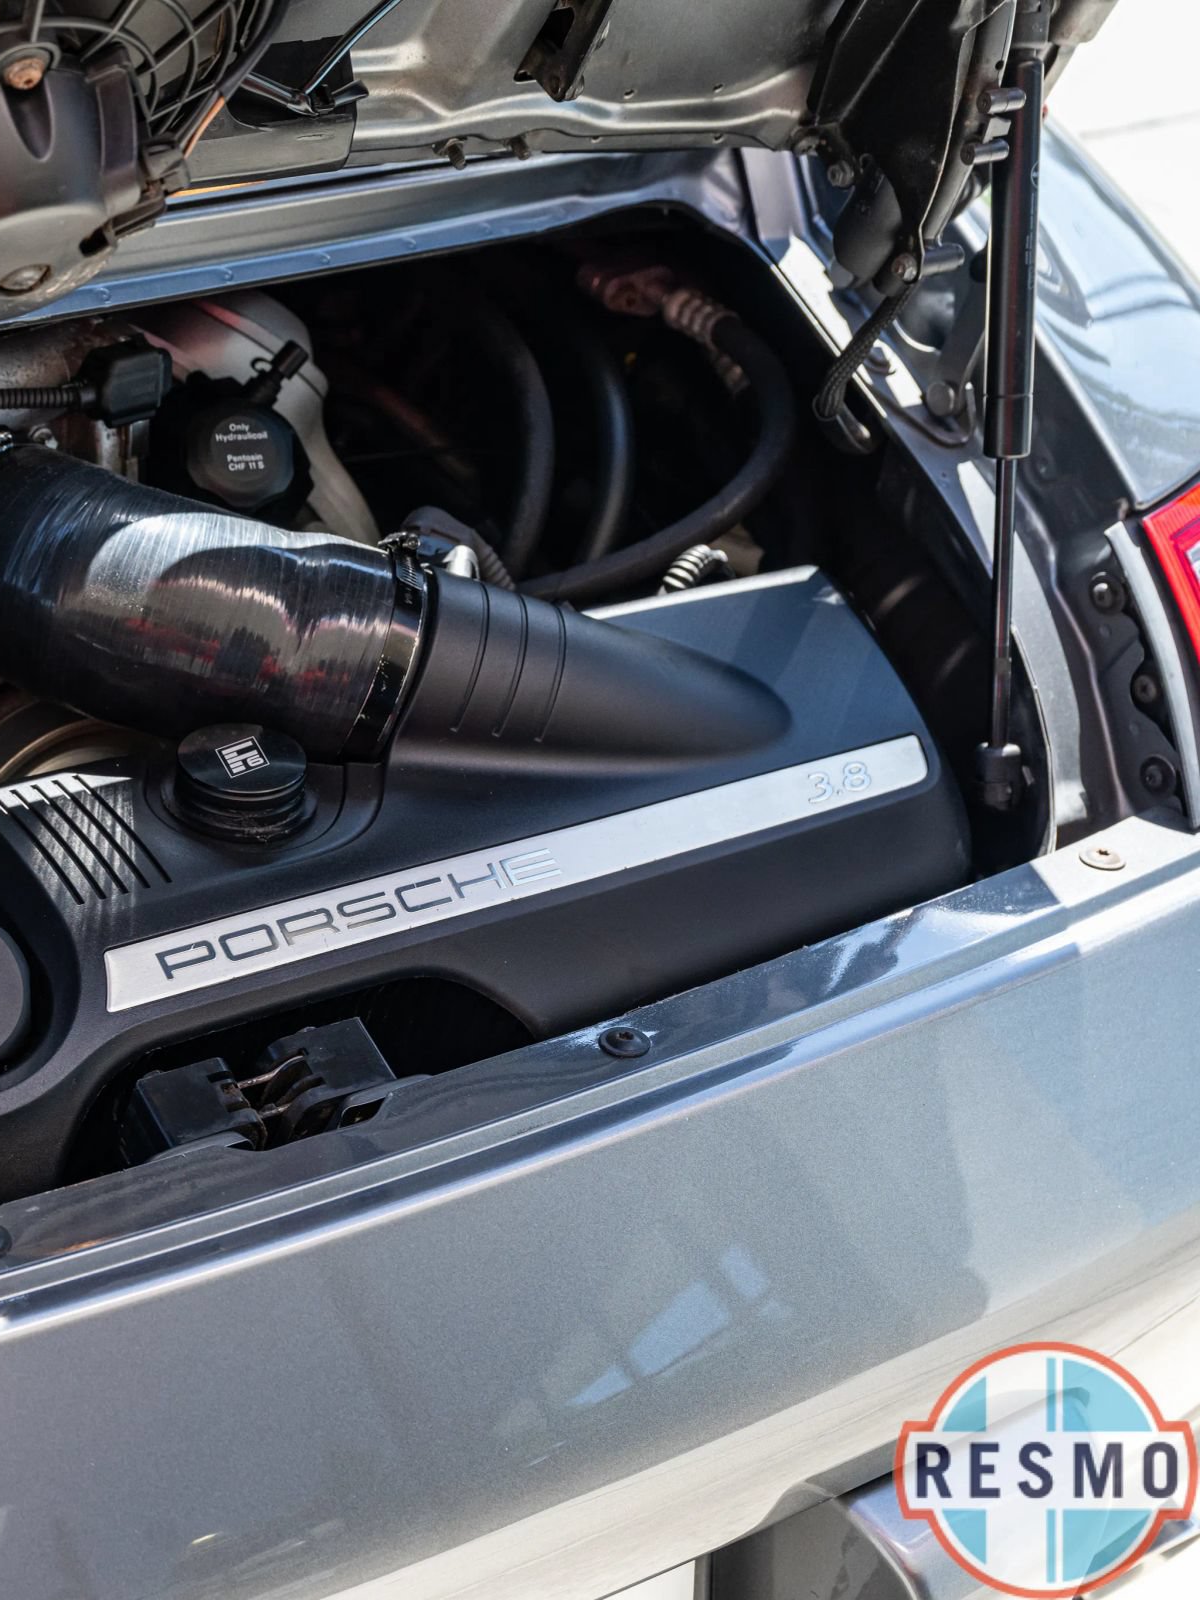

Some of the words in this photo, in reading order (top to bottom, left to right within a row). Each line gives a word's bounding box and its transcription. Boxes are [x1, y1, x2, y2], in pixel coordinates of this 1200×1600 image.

[229, 423, 249, 431] Only
[215, 432, 268, 443] Hydraulicoil
[227, 453, 263, 462] Pentosin
[228, 462, 245, 471] CHF
[248, 462, 256, 470] 11
[807, 761, 871, 804] 3.8
[155, 847, 562, 980] PORSCHE
